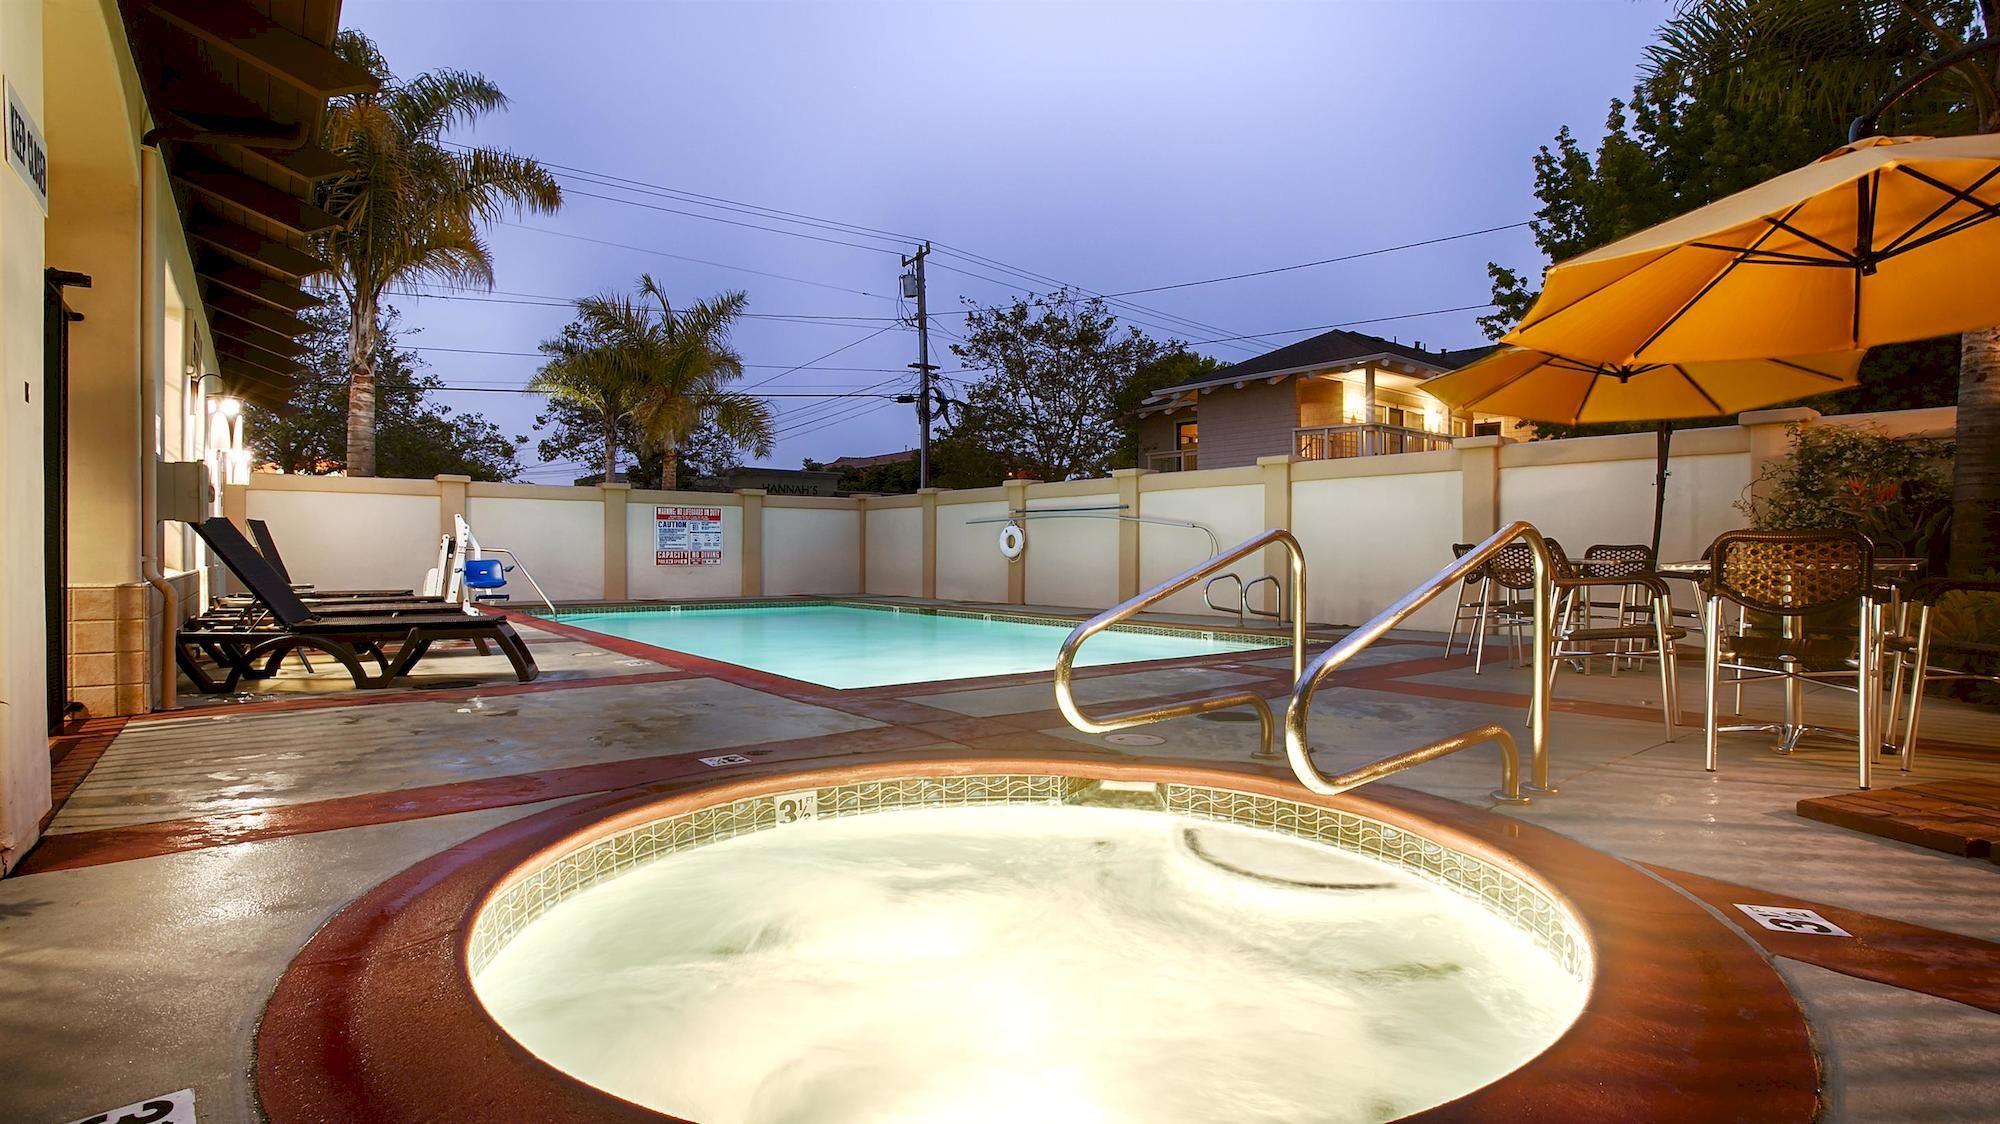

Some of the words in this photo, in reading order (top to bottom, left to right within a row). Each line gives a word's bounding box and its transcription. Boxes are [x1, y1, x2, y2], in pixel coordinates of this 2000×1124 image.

[10, 101, 26, 167] KEEP
[27, 130, 47, 198] CLOSED
[762, 483, 819, 495] HANNAH'S
[657, 551, 689, 559] CAPACITY
[691, 551, 700, 559] NO
[701, 551, 720, 559] DIVING
